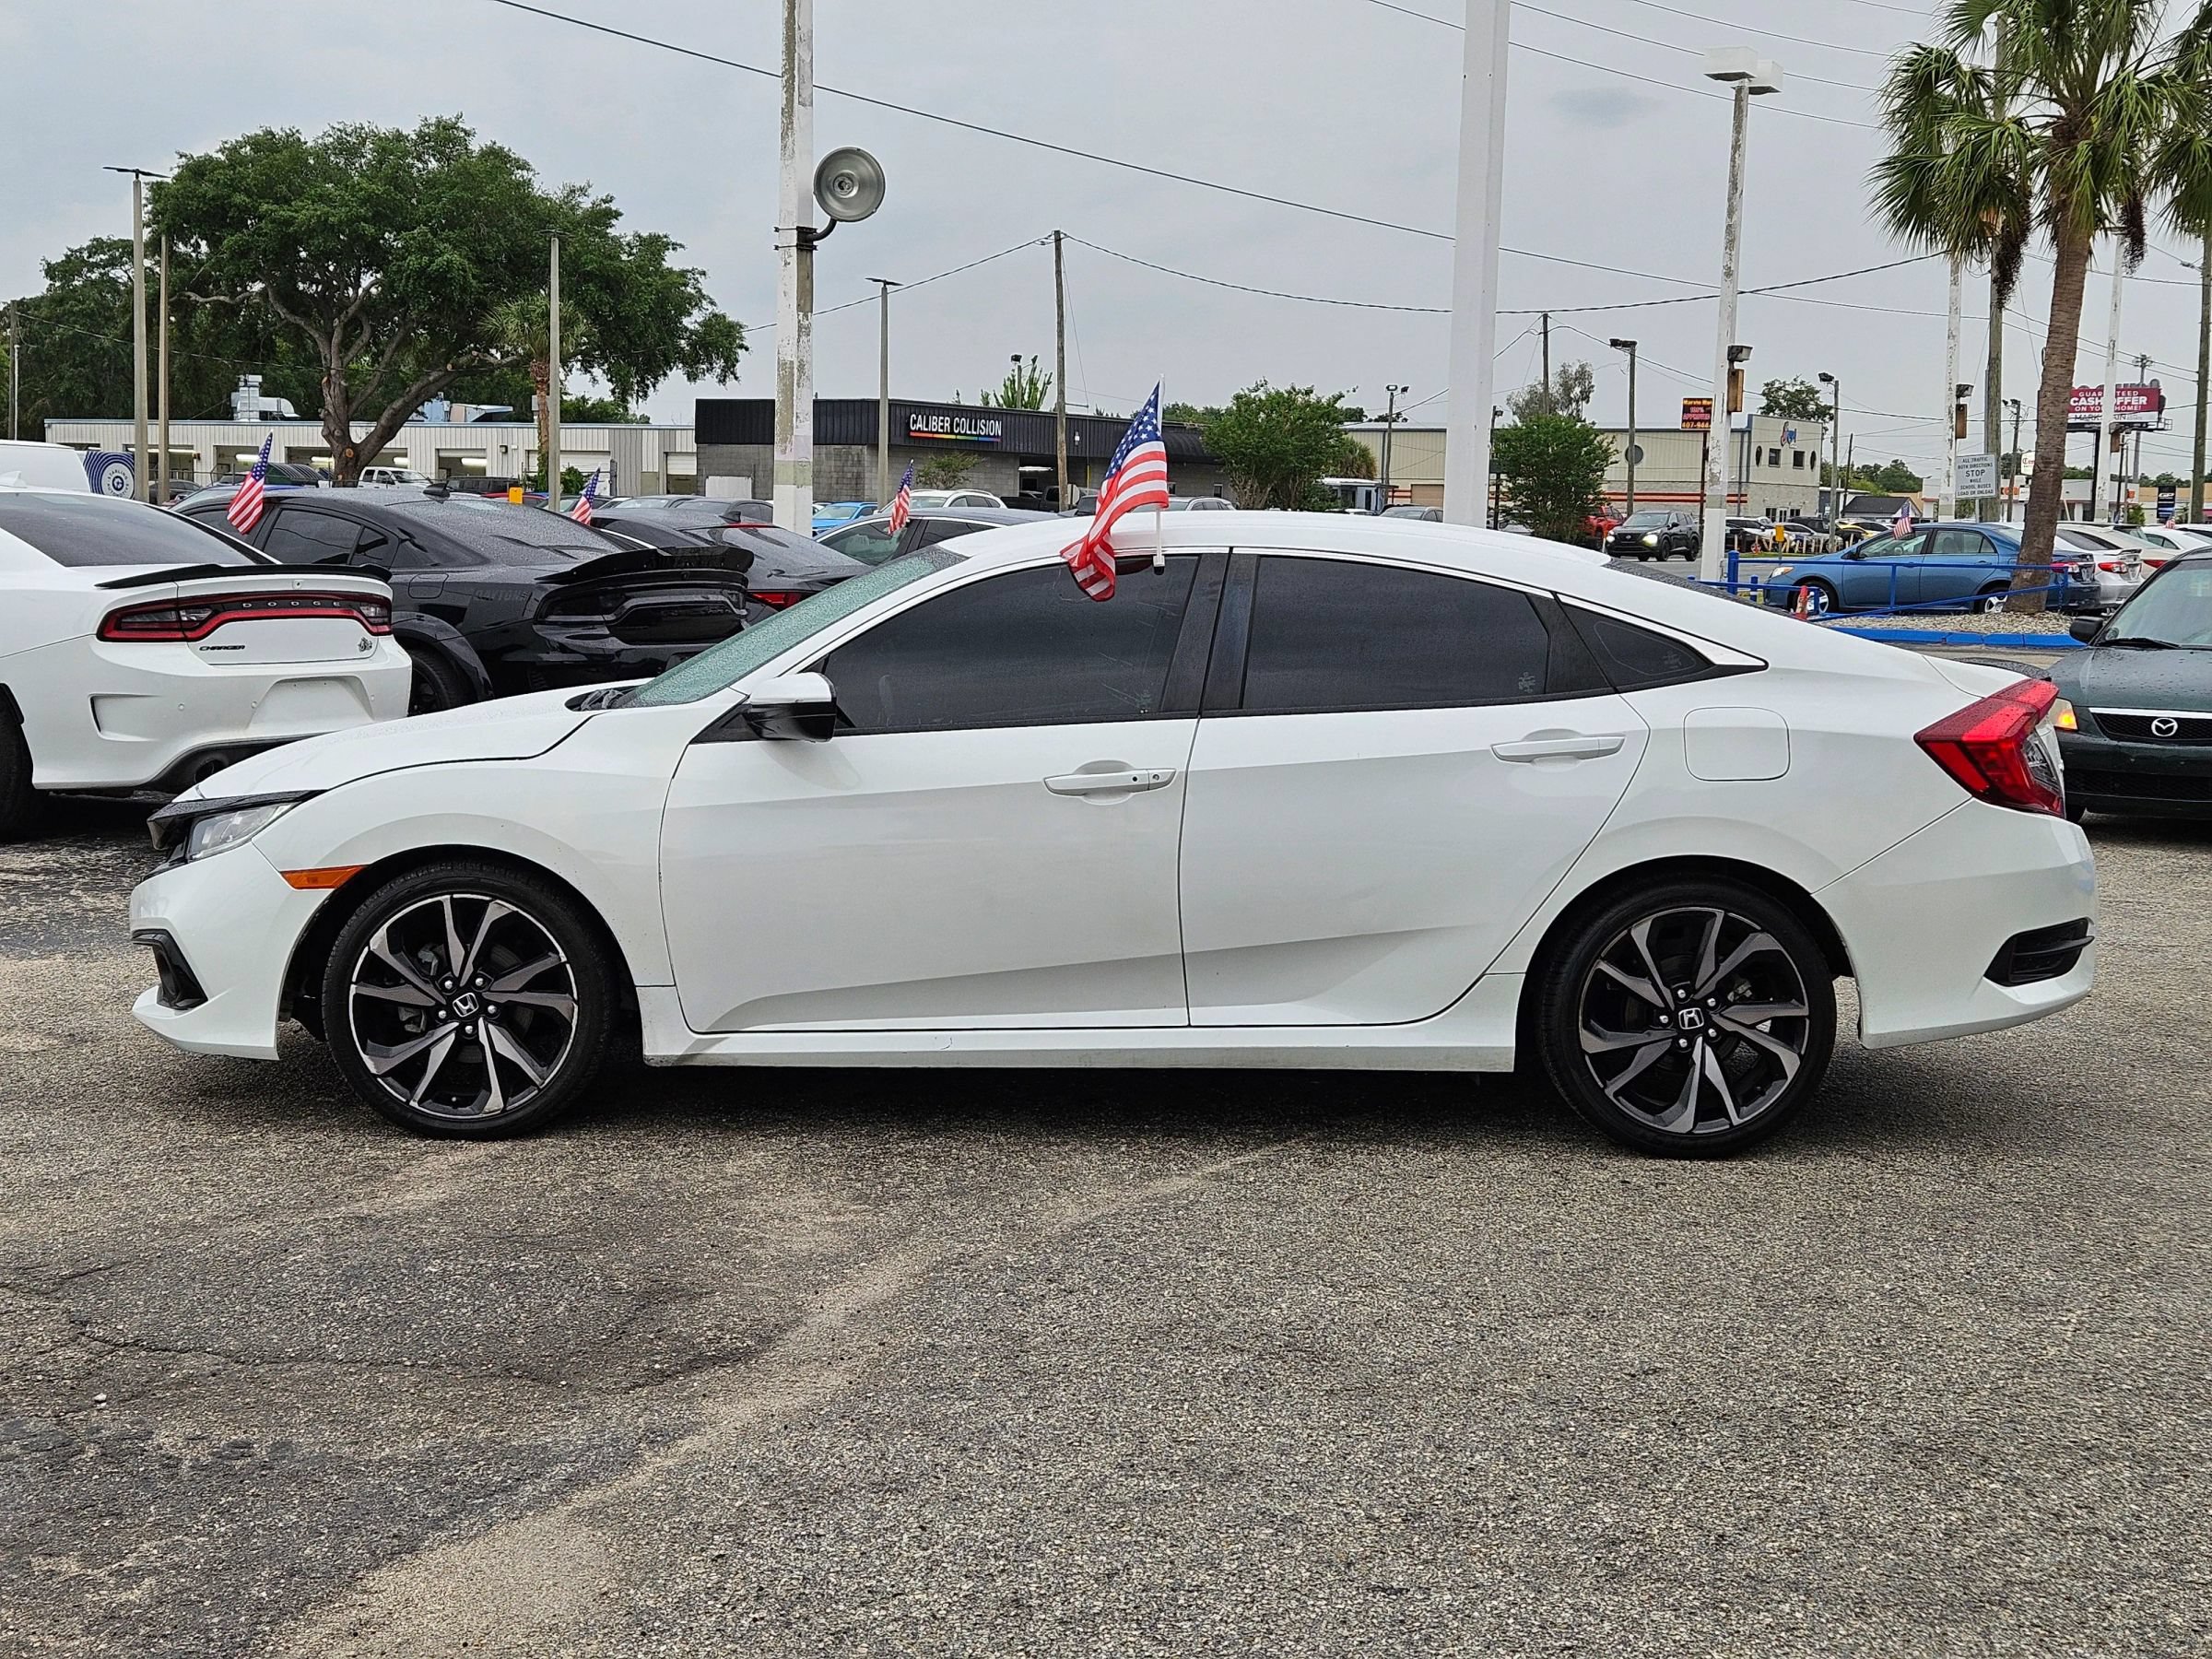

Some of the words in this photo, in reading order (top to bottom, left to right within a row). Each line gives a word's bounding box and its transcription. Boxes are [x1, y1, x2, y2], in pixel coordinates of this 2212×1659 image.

[2113, 395, 2147, 406] FFER
[910, 414, 950, 432] CALIBER
[953, 417, 1002, 436] COLLISION
[1965, 469, 1985, 477] STOP
[242, 600, 341, 608] DODGE
